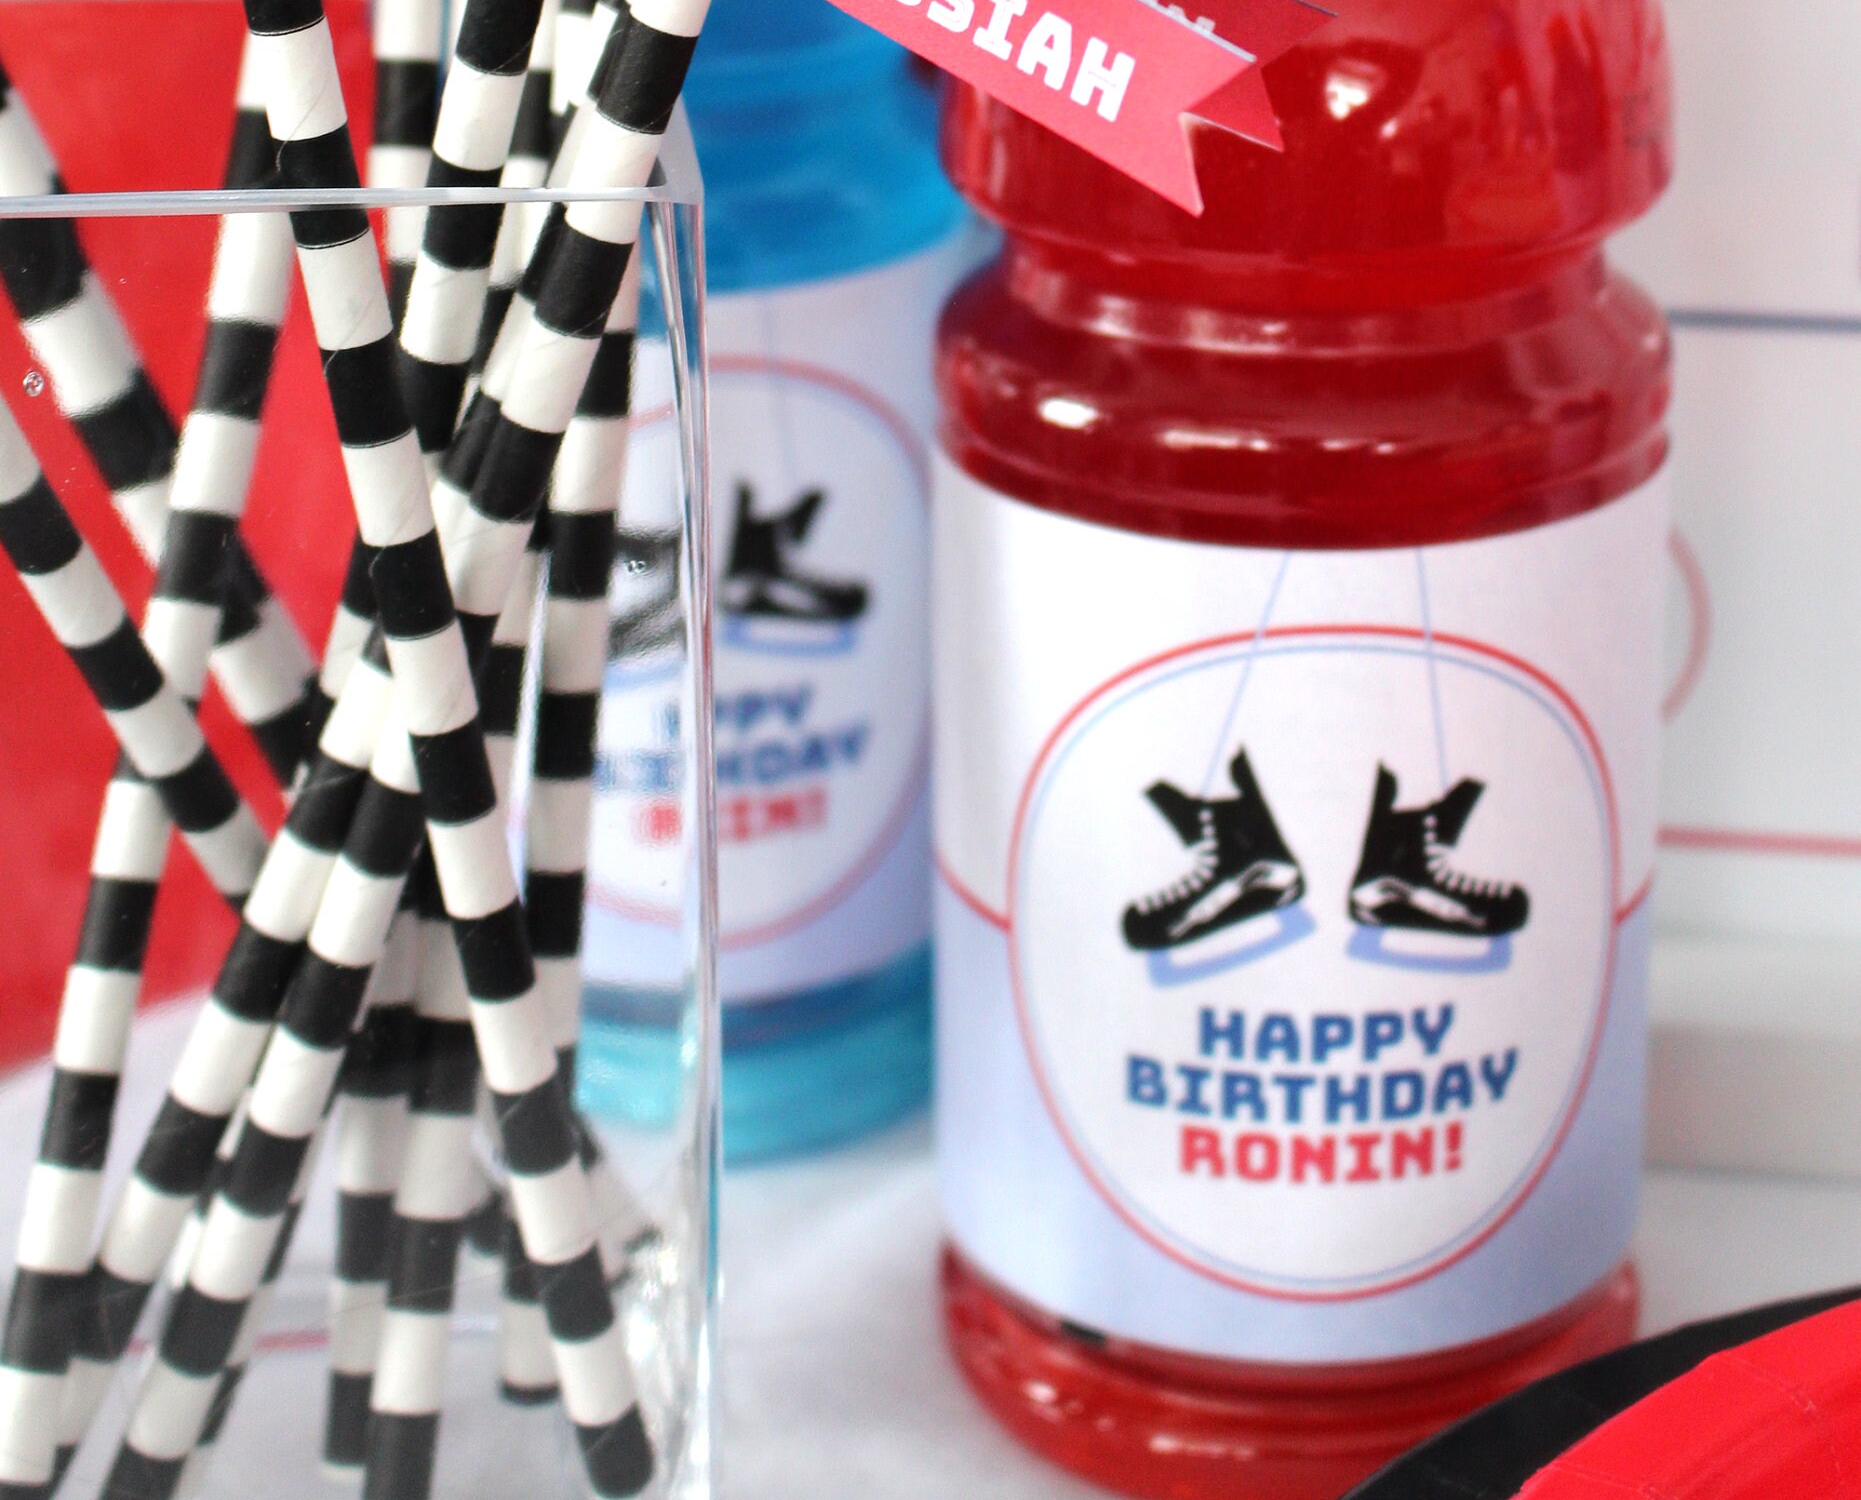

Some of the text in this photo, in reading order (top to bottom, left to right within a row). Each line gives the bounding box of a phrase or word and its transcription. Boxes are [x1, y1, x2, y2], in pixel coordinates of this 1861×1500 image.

[1198, 1002, 1455, 1064] HAPPY
[1125, 1047, 1519, 1125] BIRTHDAY
[1178, 1120, 1464, 1185] RONIN!
